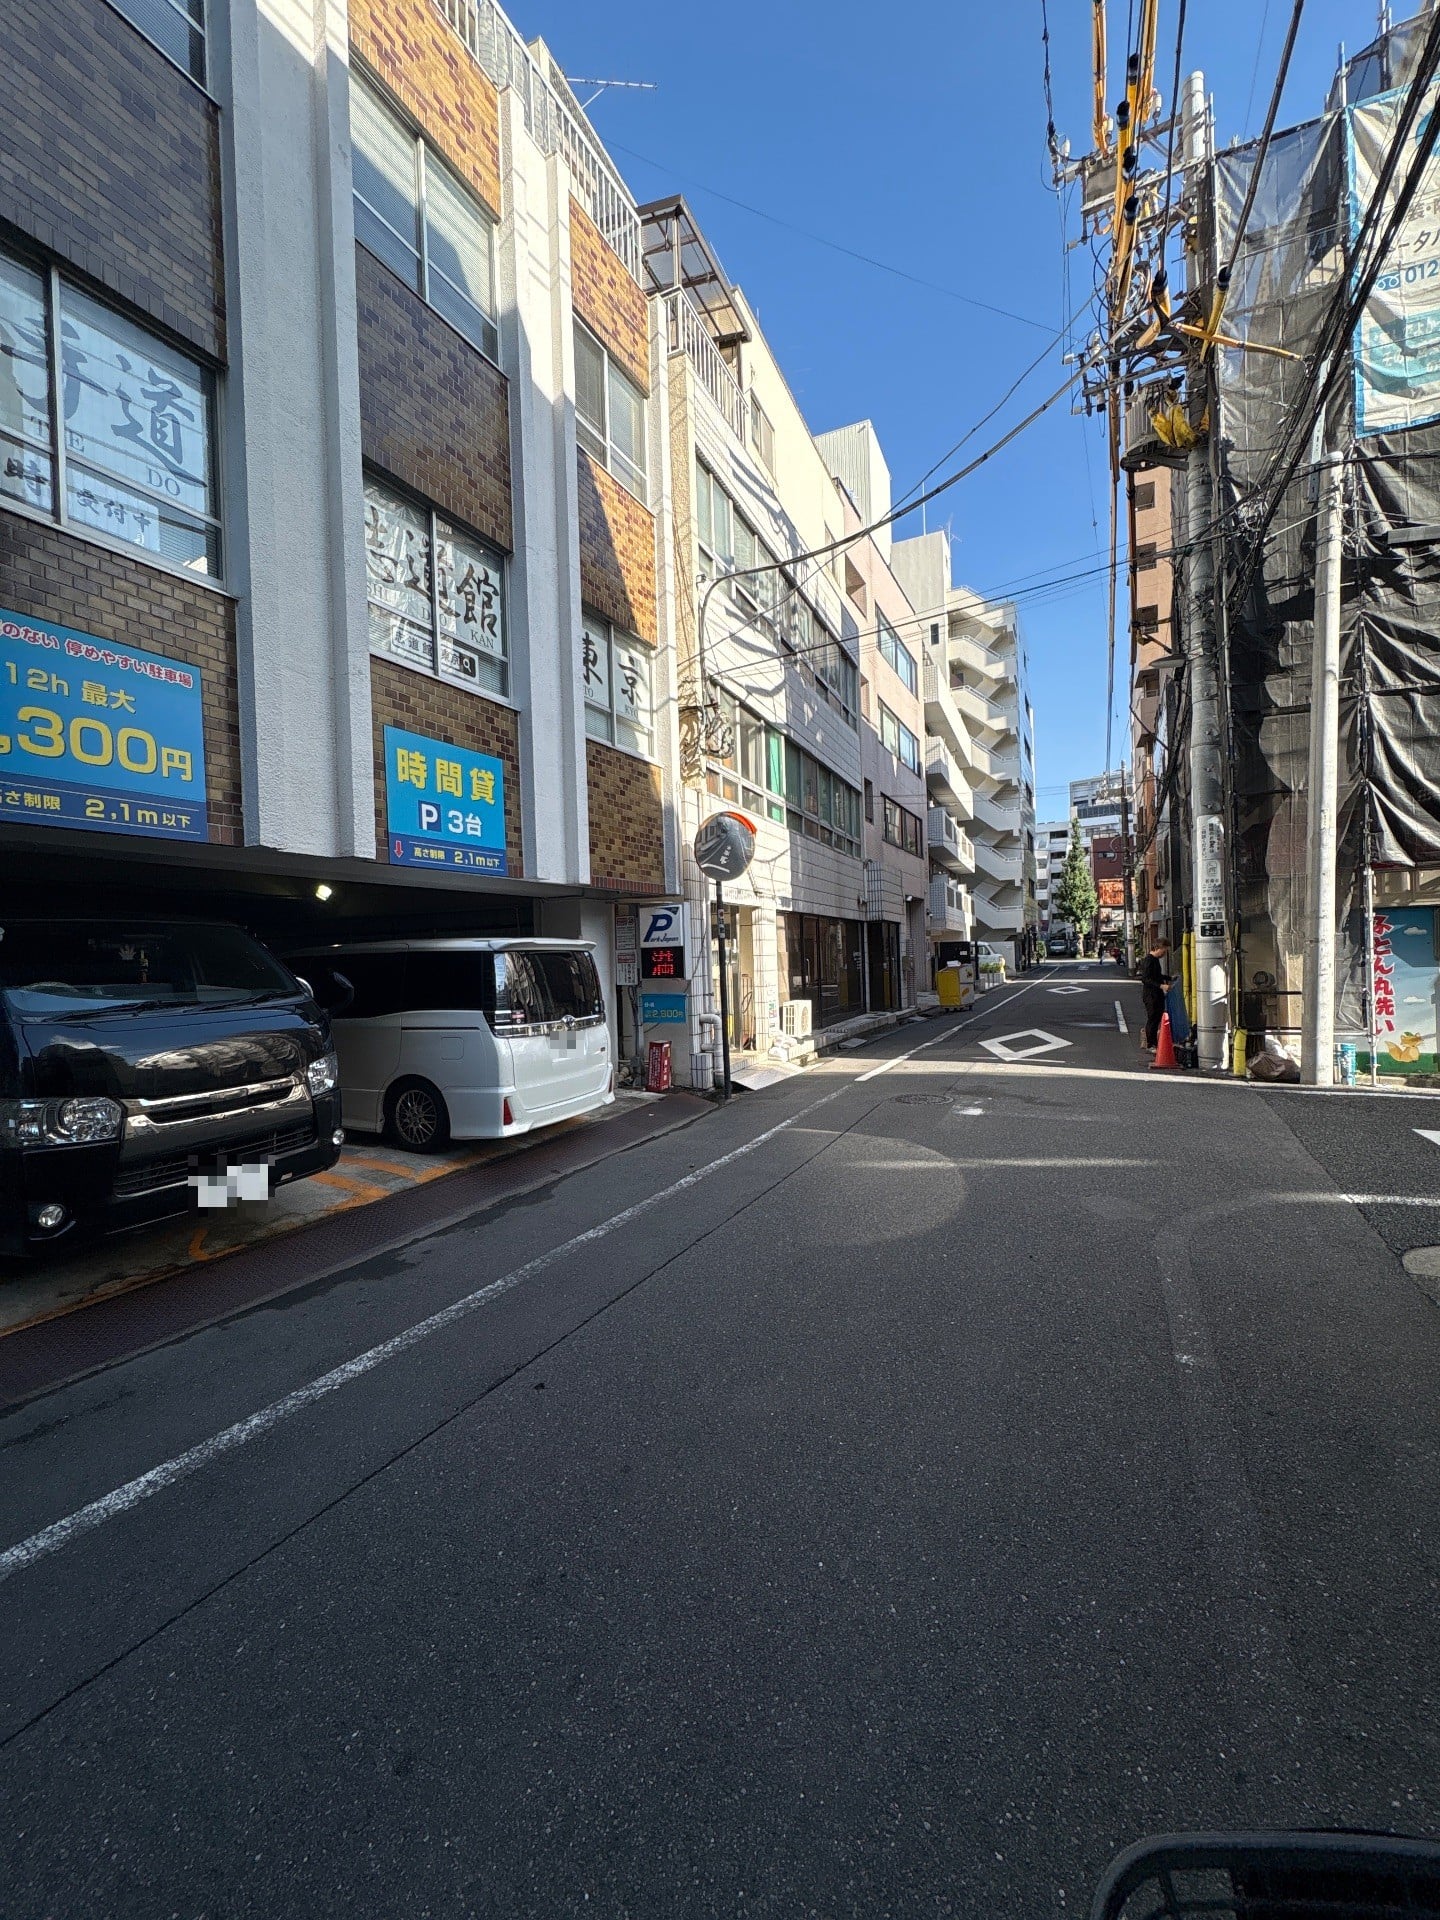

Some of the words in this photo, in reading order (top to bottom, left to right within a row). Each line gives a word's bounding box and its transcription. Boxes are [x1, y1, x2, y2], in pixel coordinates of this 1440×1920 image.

[147, 465, 182, 497] DO
[470, 628, 495, 650] KAN
[65, 638, 194, 689] 停めやすい駐車場
[5, 661, 69, 697] 12h
[81, 680, 137, 714] 最大
[396, 748, 495, 805] 時間貸
[421, 803, 438, 831] P
[447, 810, 482, 838] 3台
[413, 847, 446, 860] 高さ制限
